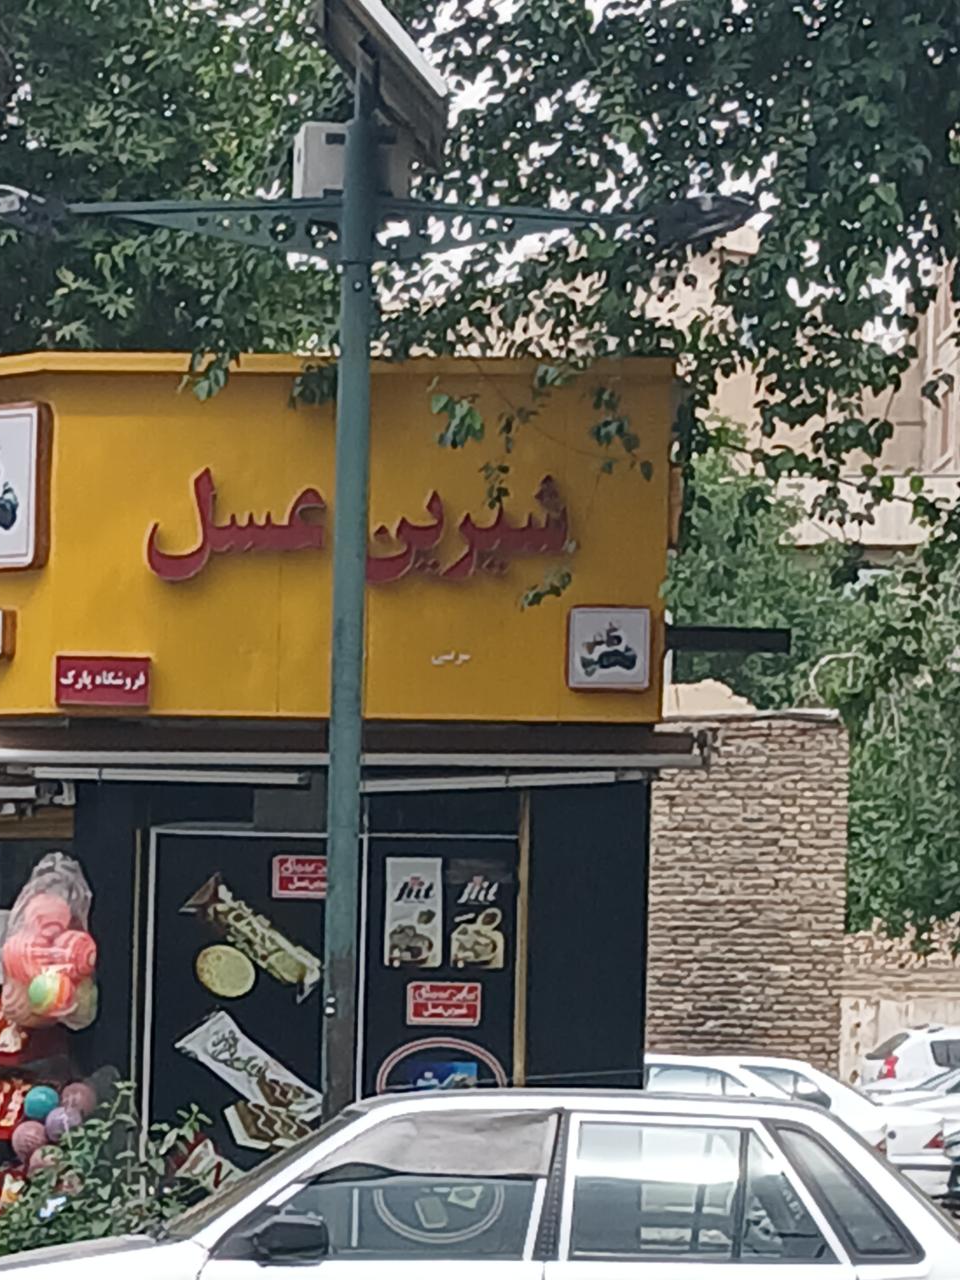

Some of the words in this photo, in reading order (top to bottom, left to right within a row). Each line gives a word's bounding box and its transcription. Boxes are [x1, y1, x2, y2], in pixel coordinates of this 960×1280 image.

[146, 466, 327, 583] عسل
[365, 475, 570, 582] شیرین
[59, 669, 93, 691] پارک
[94, 669, 146, 691] فروشگاه
